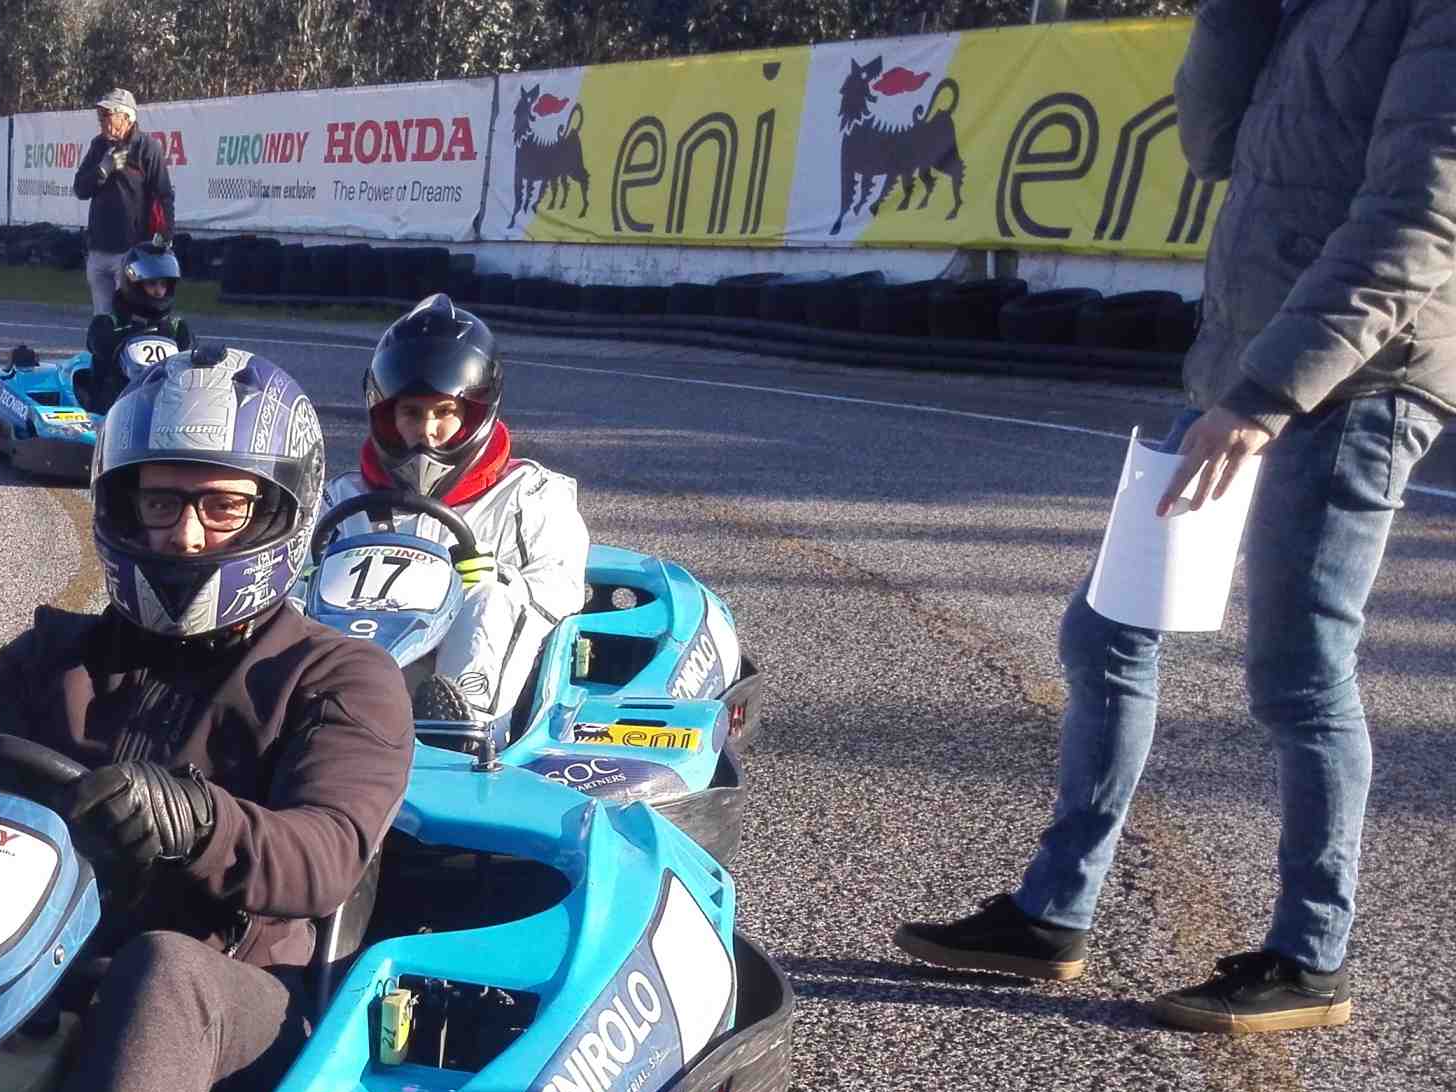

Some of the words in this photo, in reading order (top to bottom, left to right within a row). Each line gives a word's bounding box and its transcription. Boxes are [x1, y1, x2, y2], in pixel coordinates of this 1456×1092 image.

[215, 130, 309, 166] EUROINDY
[323, 114, 478, 165] HONDA
[610, 61, 781, 236] eni
[995, 91, 1224, 243] en
[333, 179, 355, 200] The
[359, 179, 395, 201] Power
[397, 180, 407, 201] of
[410, 179, 463, 203] Dreams
[142, 345, 167, 363] 20
[344, 547, 439, 564] EUROINDY
[349, 555, 412, 600] 17
[622, 728, 692, 749] eni
[575, 772, 627, 794] ARTNERS
